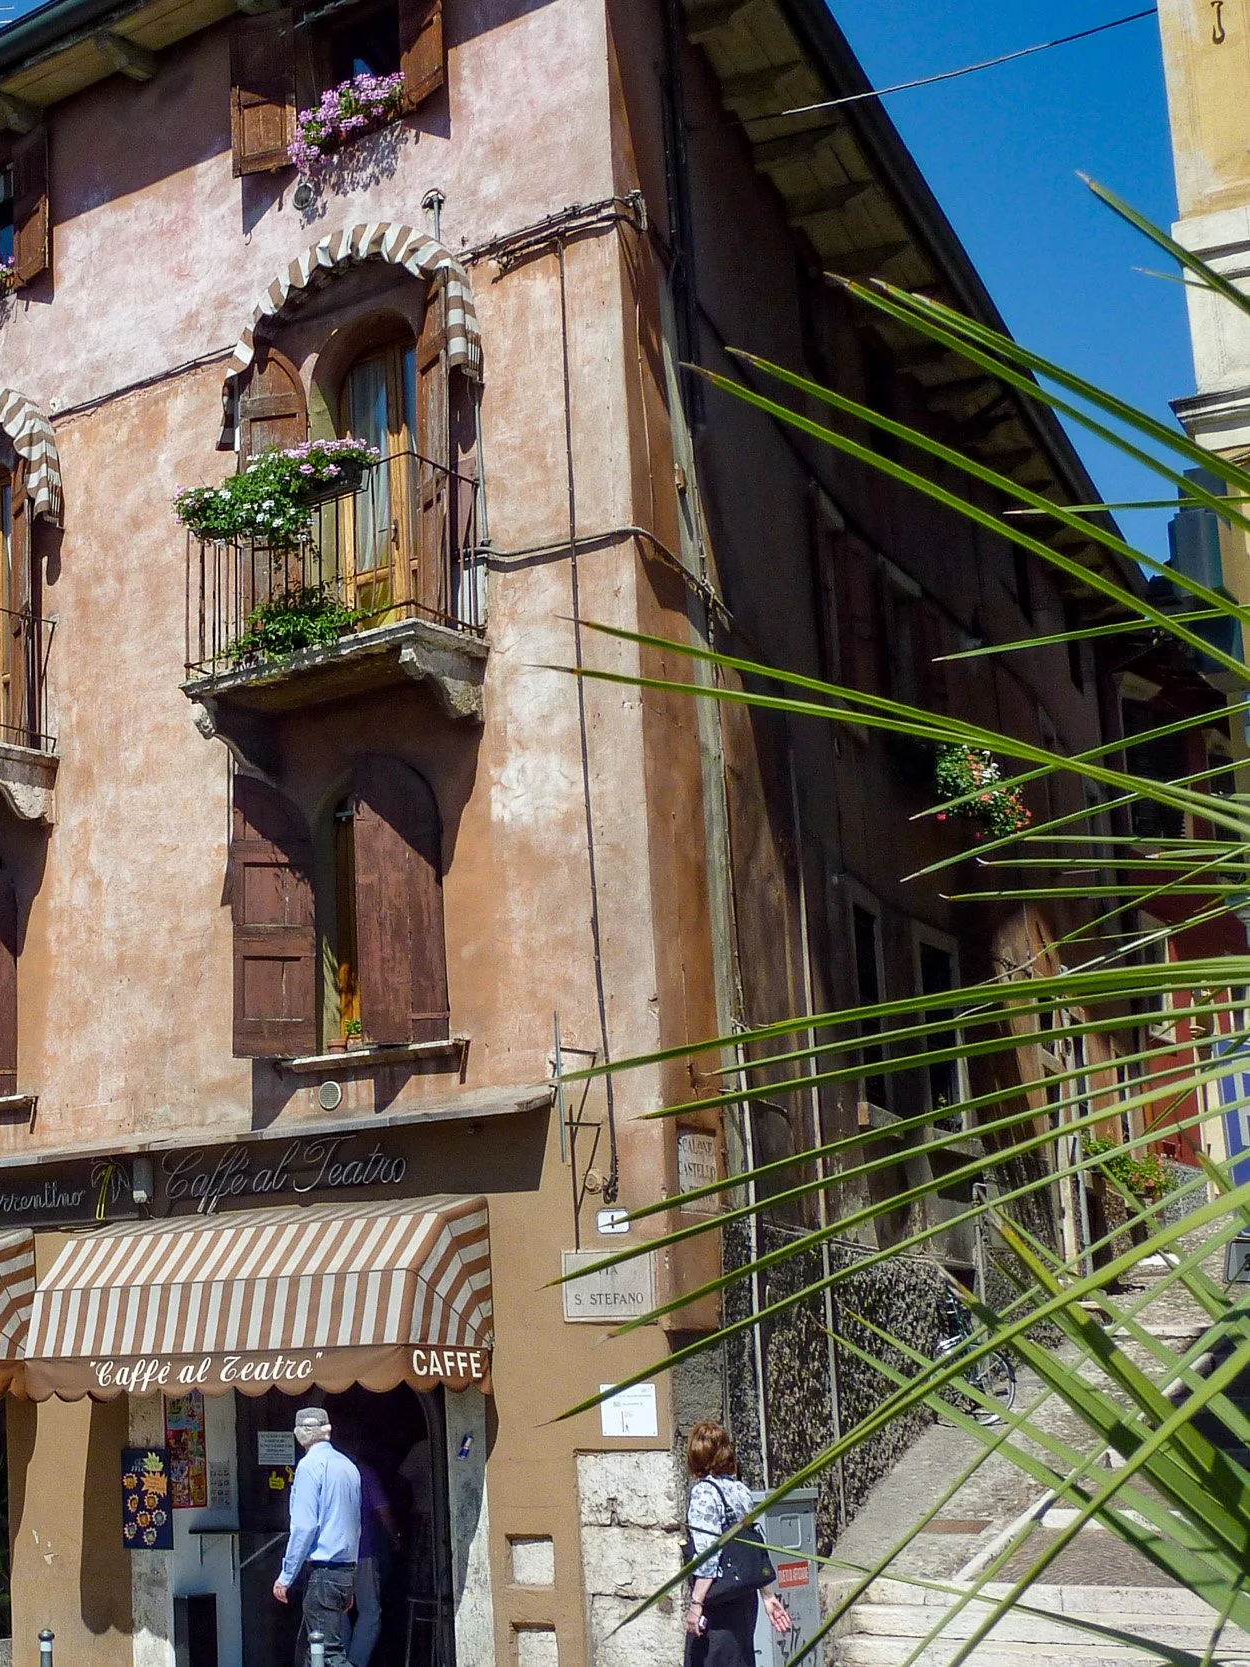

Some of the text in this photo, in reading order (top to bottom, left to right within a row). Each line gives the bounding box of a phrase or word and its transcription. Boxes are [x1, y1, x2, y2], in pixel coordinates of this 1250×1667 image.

[252, 1140, 300, 1193] al
[292, 1134, 408, 1193] Teatro
[590, 1293, 644, 1306] STEFANO
[177, 1357, 212, 1382] al
